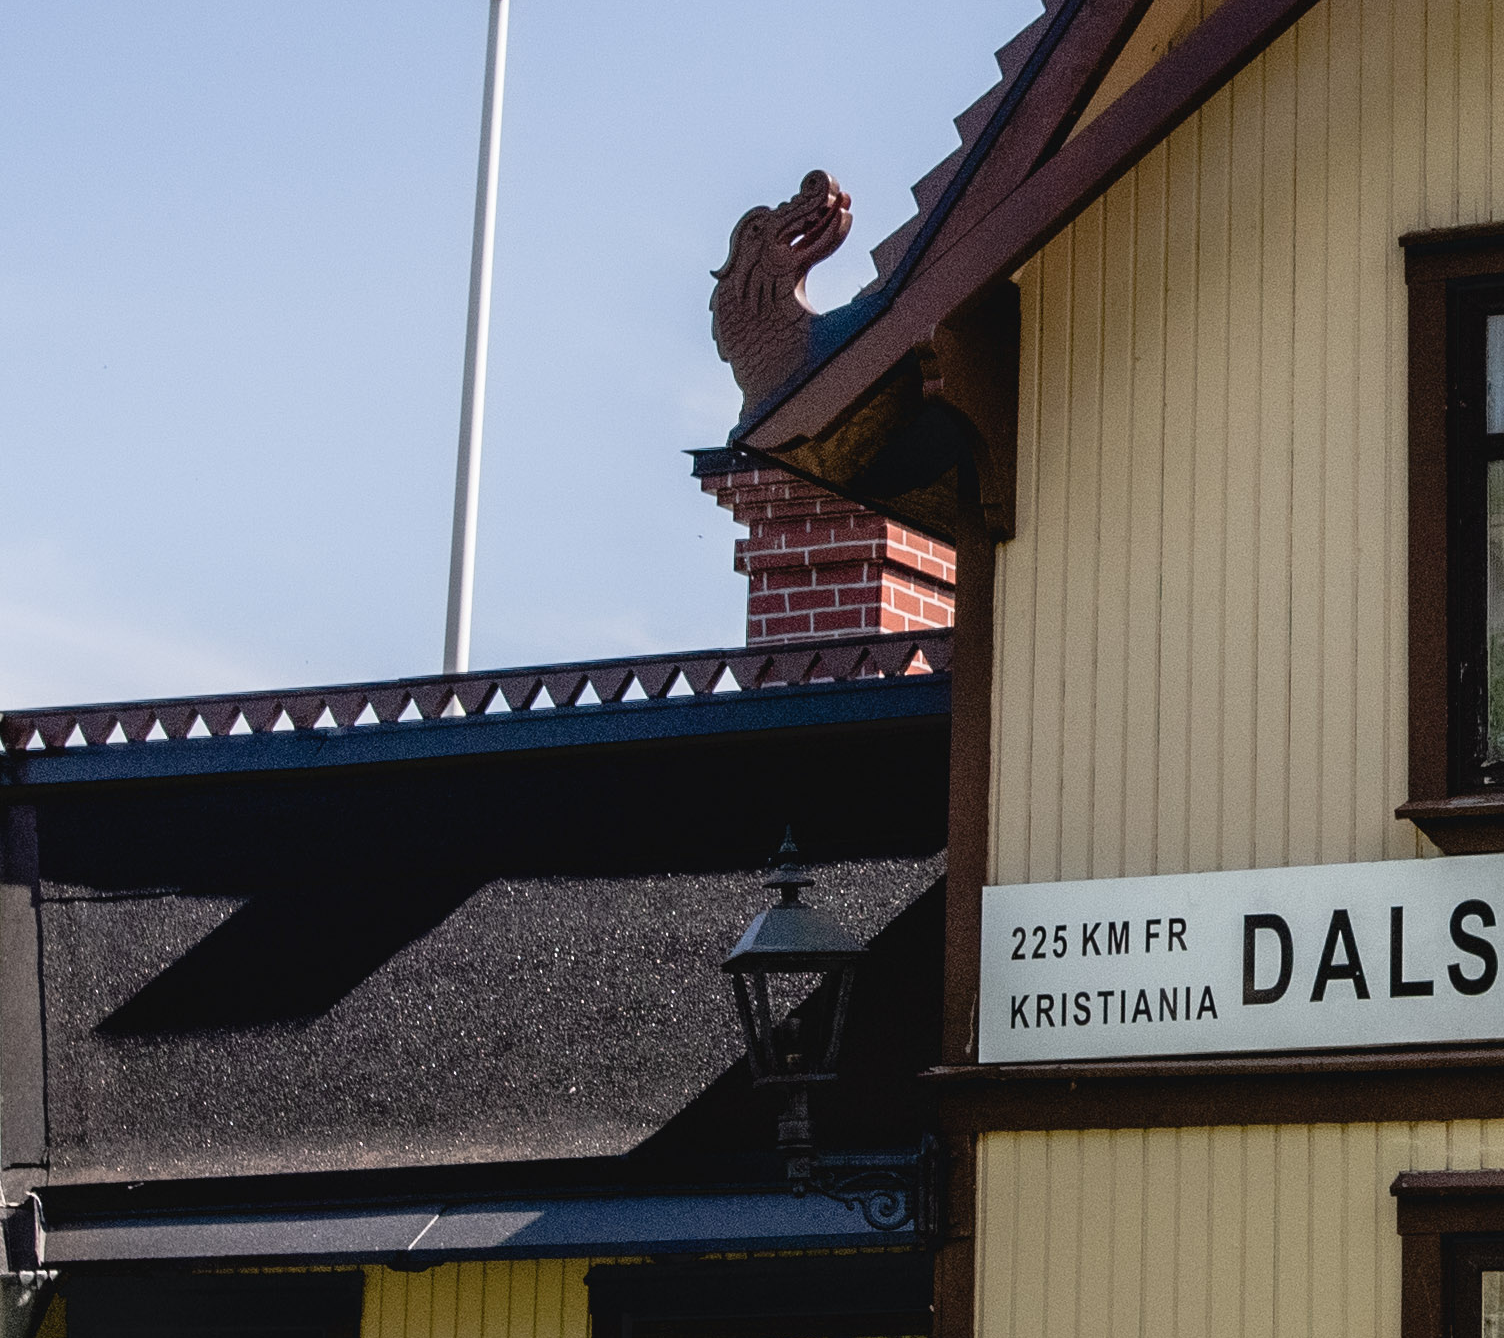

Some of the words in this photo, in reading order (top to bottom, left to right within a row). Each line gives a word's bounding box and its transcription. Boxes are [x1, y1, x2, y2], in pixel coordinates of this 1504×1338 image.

[1010, 925, 1068, 961] 225
[1081, 920, 1130, 957] KM
[1145, 917, 1187, 953] FR
[1242, 898, 1499, 1006] DALS
[1010, 985, 1218, 1030] KRISTIANIA
